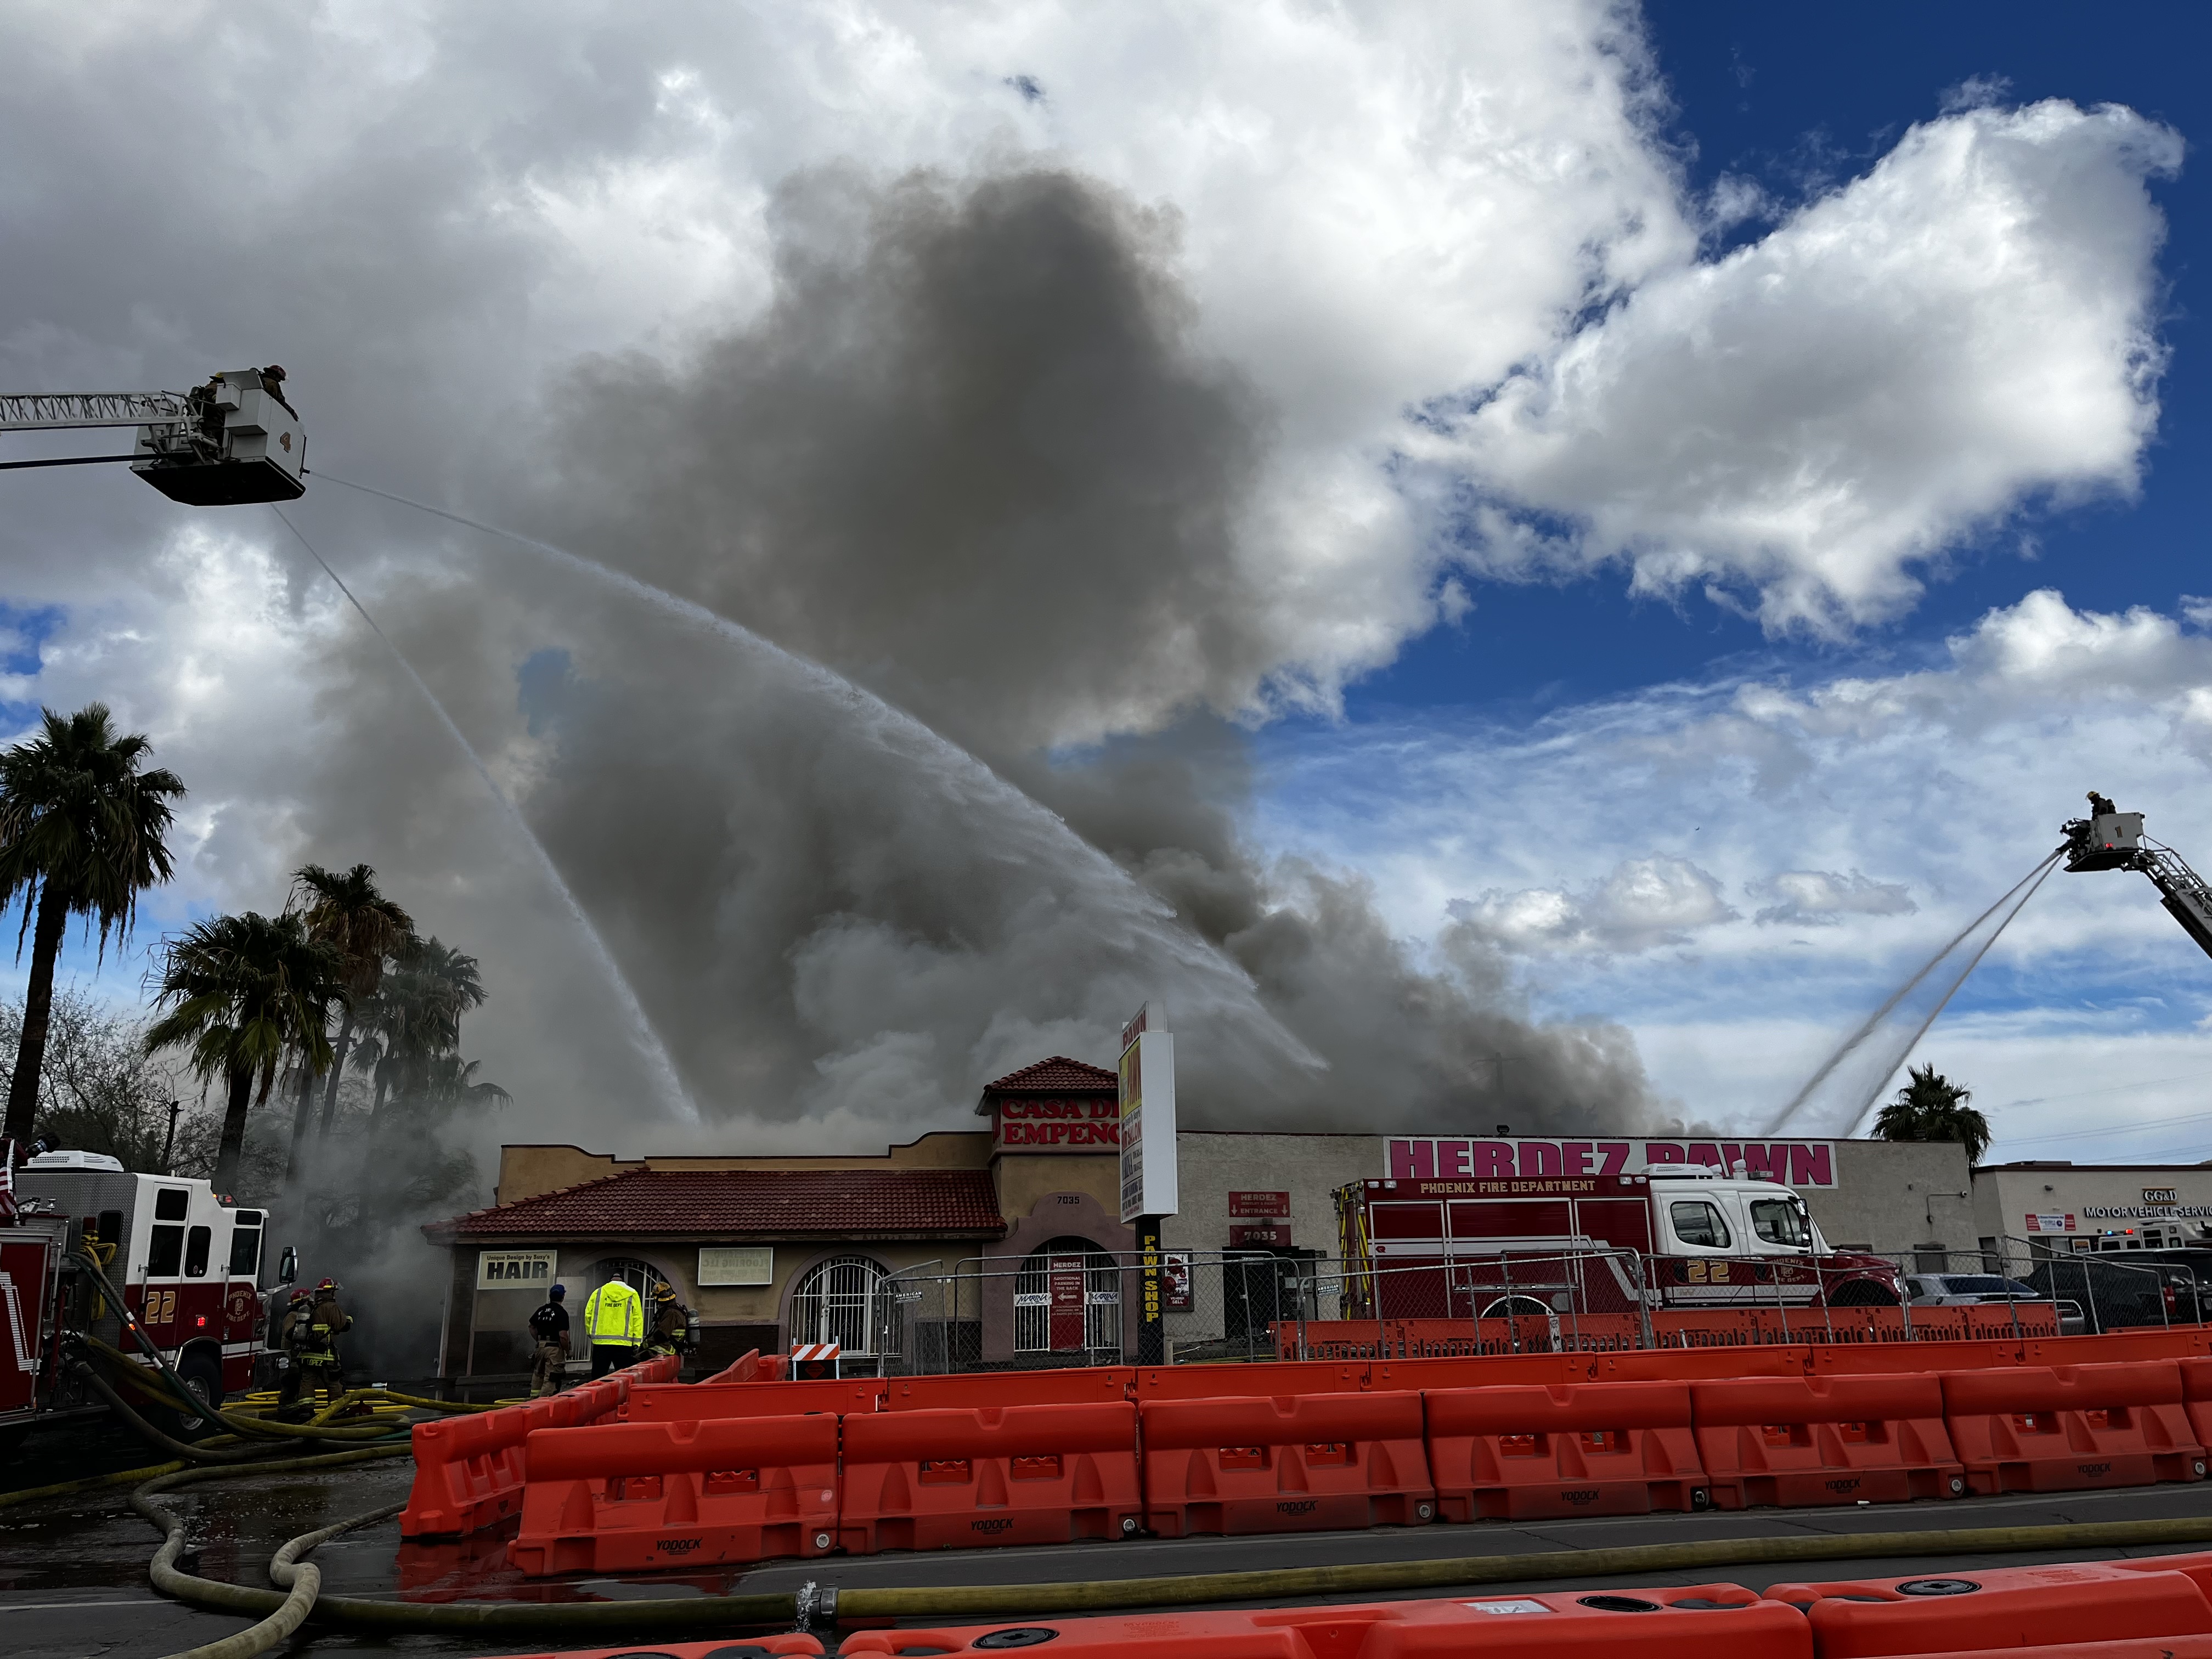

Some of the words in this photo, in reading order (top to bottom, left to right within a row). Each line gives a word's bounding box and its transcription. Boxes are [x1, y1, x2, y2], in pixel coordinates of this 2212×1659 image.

[1122, 1009, 1146, 1051] PAWN
[1002, 1098, 1084, 1119] CASA
[1390, 1140, 1630, 1178] HERDEZ
[1645, 1143, 1832, 1185] PAWN
[1420, 1182, 1476, 1194] PHOENIX
[1479, 1182, 1508, 1193] FIRE
[1511, 1180, 1596, 1193] DEPARTMENT
[1057, 1196, 1080, 1204] 7035
[2143, 1190, 2177, 1202] GG&D
[2084, 1207, 2128, 1217] MOTOR
[1244, 1231, 1277, 1240] 7035
[1143, 1235, 1158, 1277] PAWN
[487, 1261, 548, 1279] HAIR
[1687, 1260, 1730, 1283] 22
[228, 1290, 253, 1302] PHOENIX
[1017, 1292, 1048, 1305] MARINA
[1144, 1280, 1159, 1323] SHOP
[144, 1290, 176, 1324] 22
[225, 1312, 236, 1322] FIRE
[307, 1358, 324, 1367] LOPEZ
[2077, 1462, 2111, 1474] YODOCK
[1825, 1477, 1861, 1491] YODOCK
[1561, 1489, 1600, 1502] YODOCK
[1276, 1500, 1318, 1513] YODOCK
[970, 1518, 1014, 1531] YODOCK
[656, 1538, 703, 1550] YODOCK
